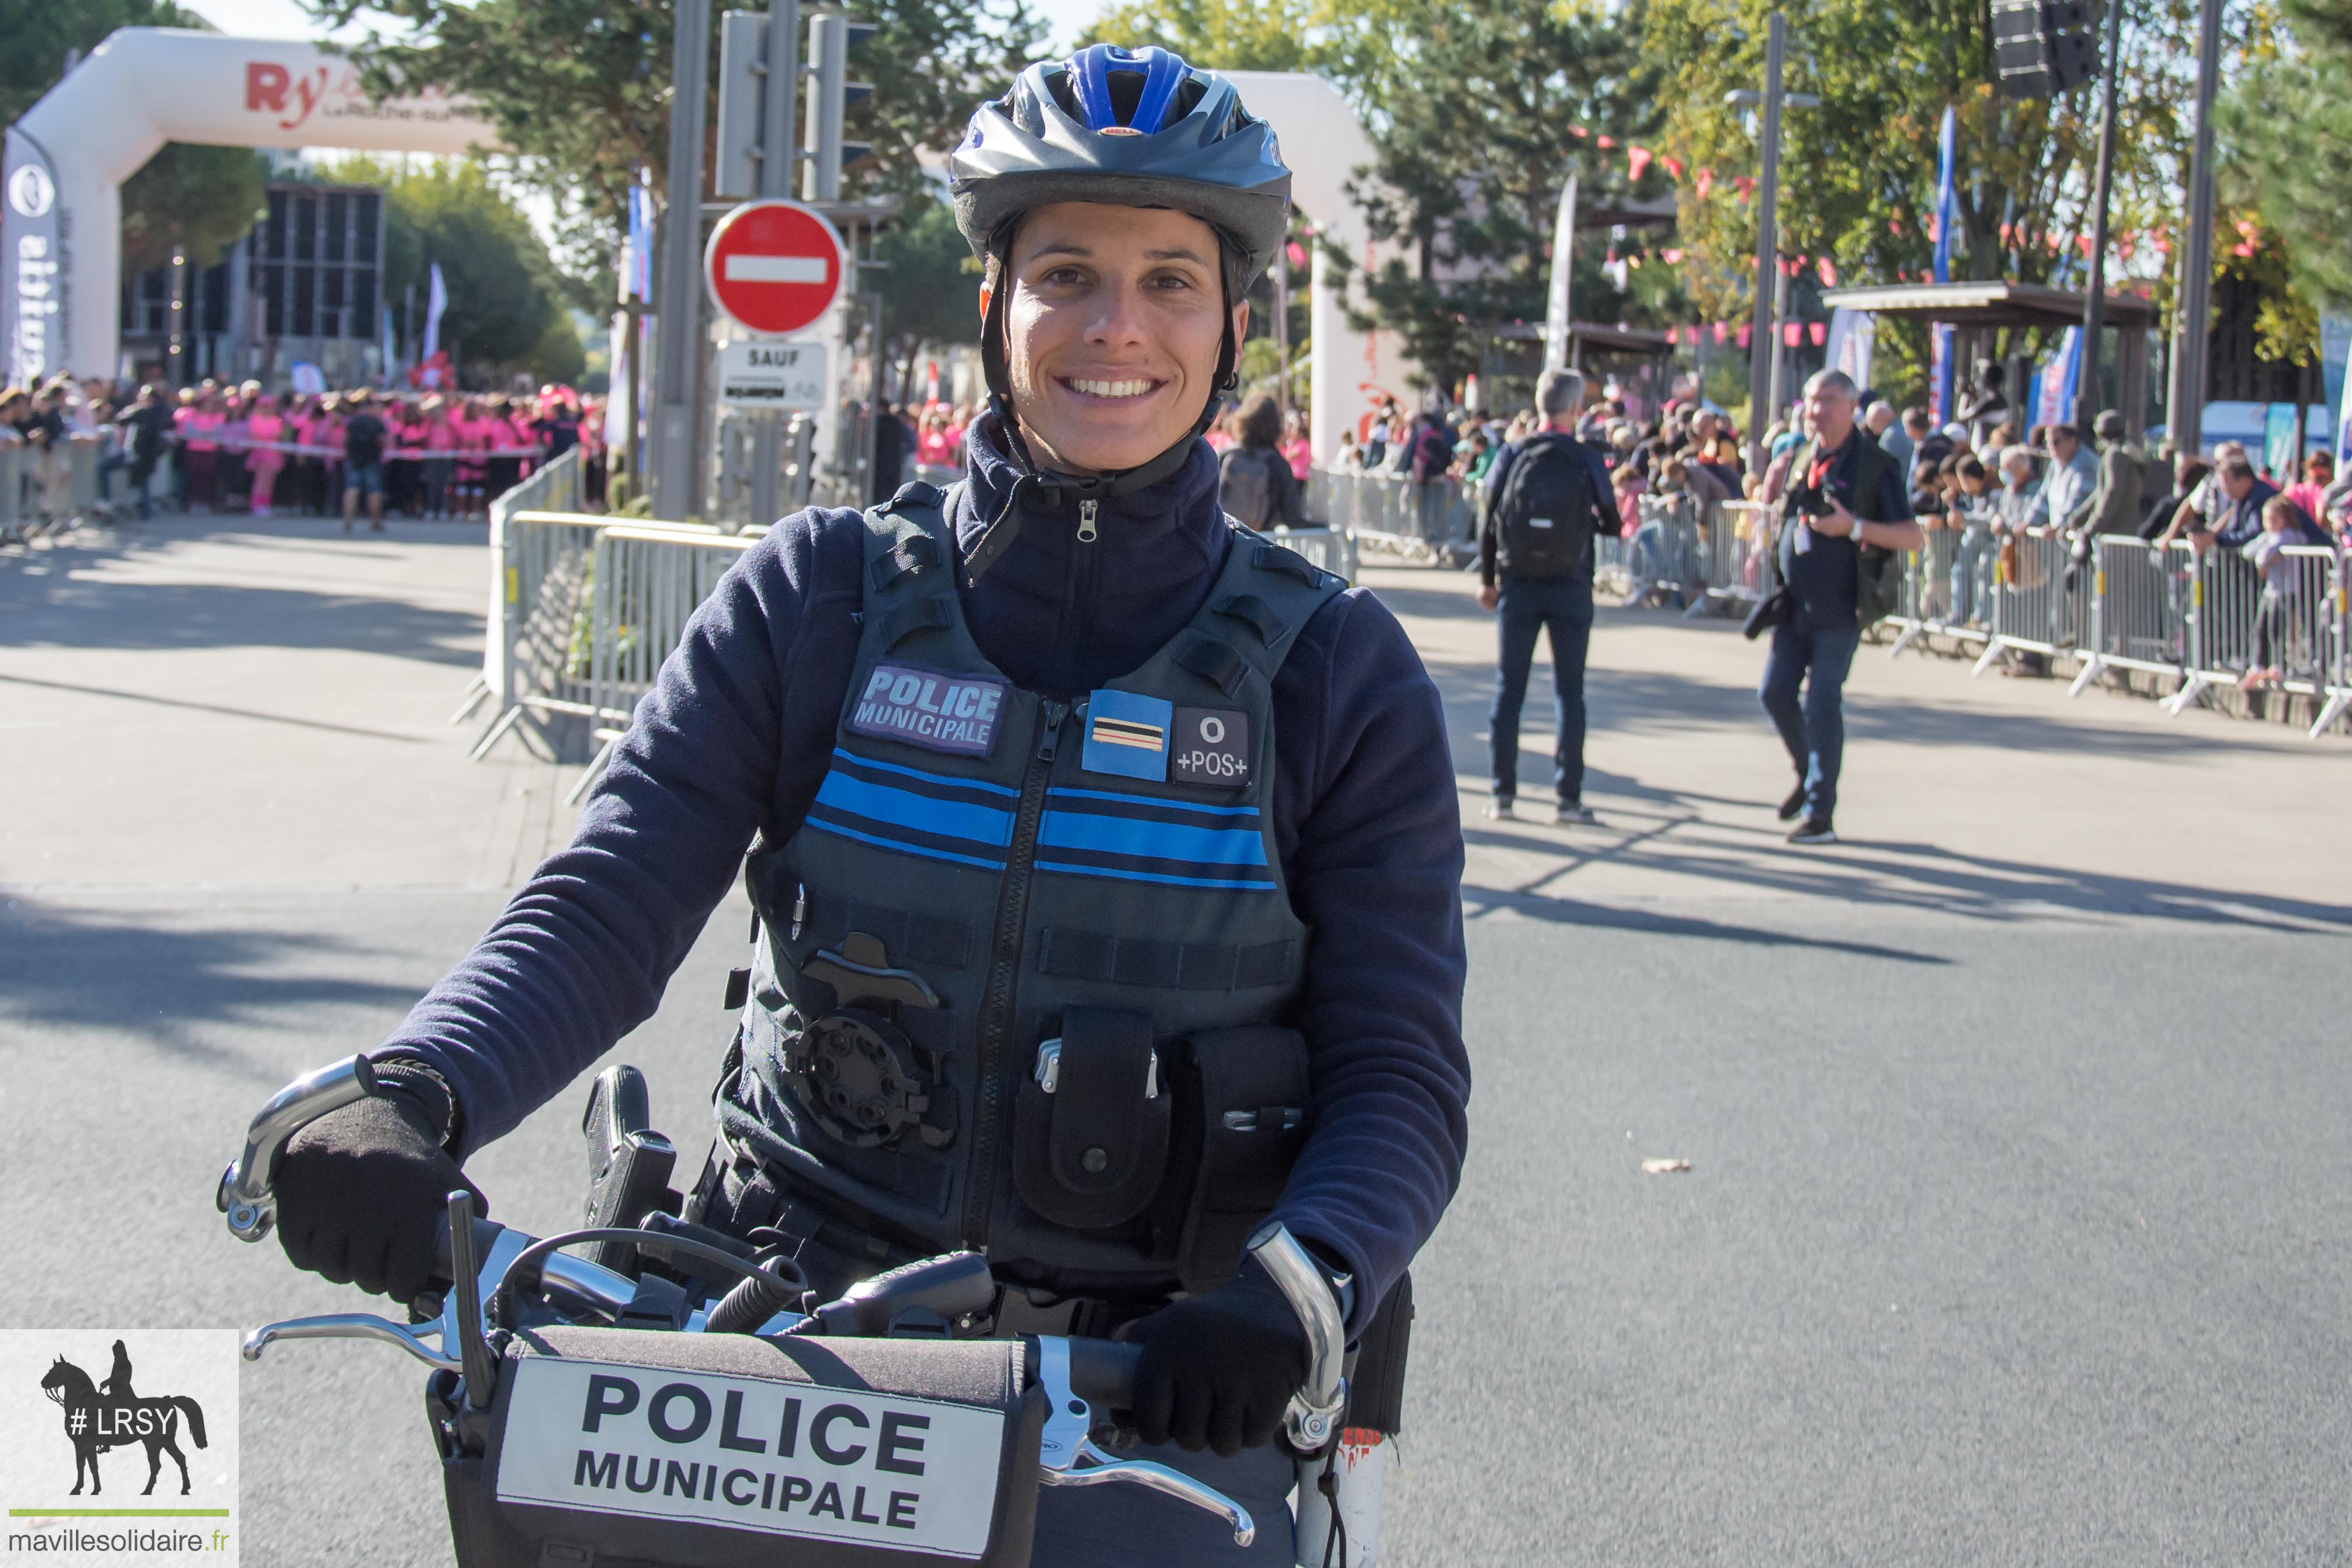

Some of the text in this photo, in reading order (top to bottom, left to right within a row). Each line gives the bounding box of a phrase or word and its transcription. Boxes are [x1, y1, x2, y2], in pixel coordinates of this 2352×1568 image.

[245, 61, 328, 130] Ry
[749, 349, 799, 366] SAUF
[864, 671, 1002, 722] POLICE
[854, 702, 991, 745] MUNICIPALE
[1200, 717, 1225, 743] O
[582, 1374, 930, 1476] POLICE
[574, 1449, 919, 1529] MUNICIPALE
